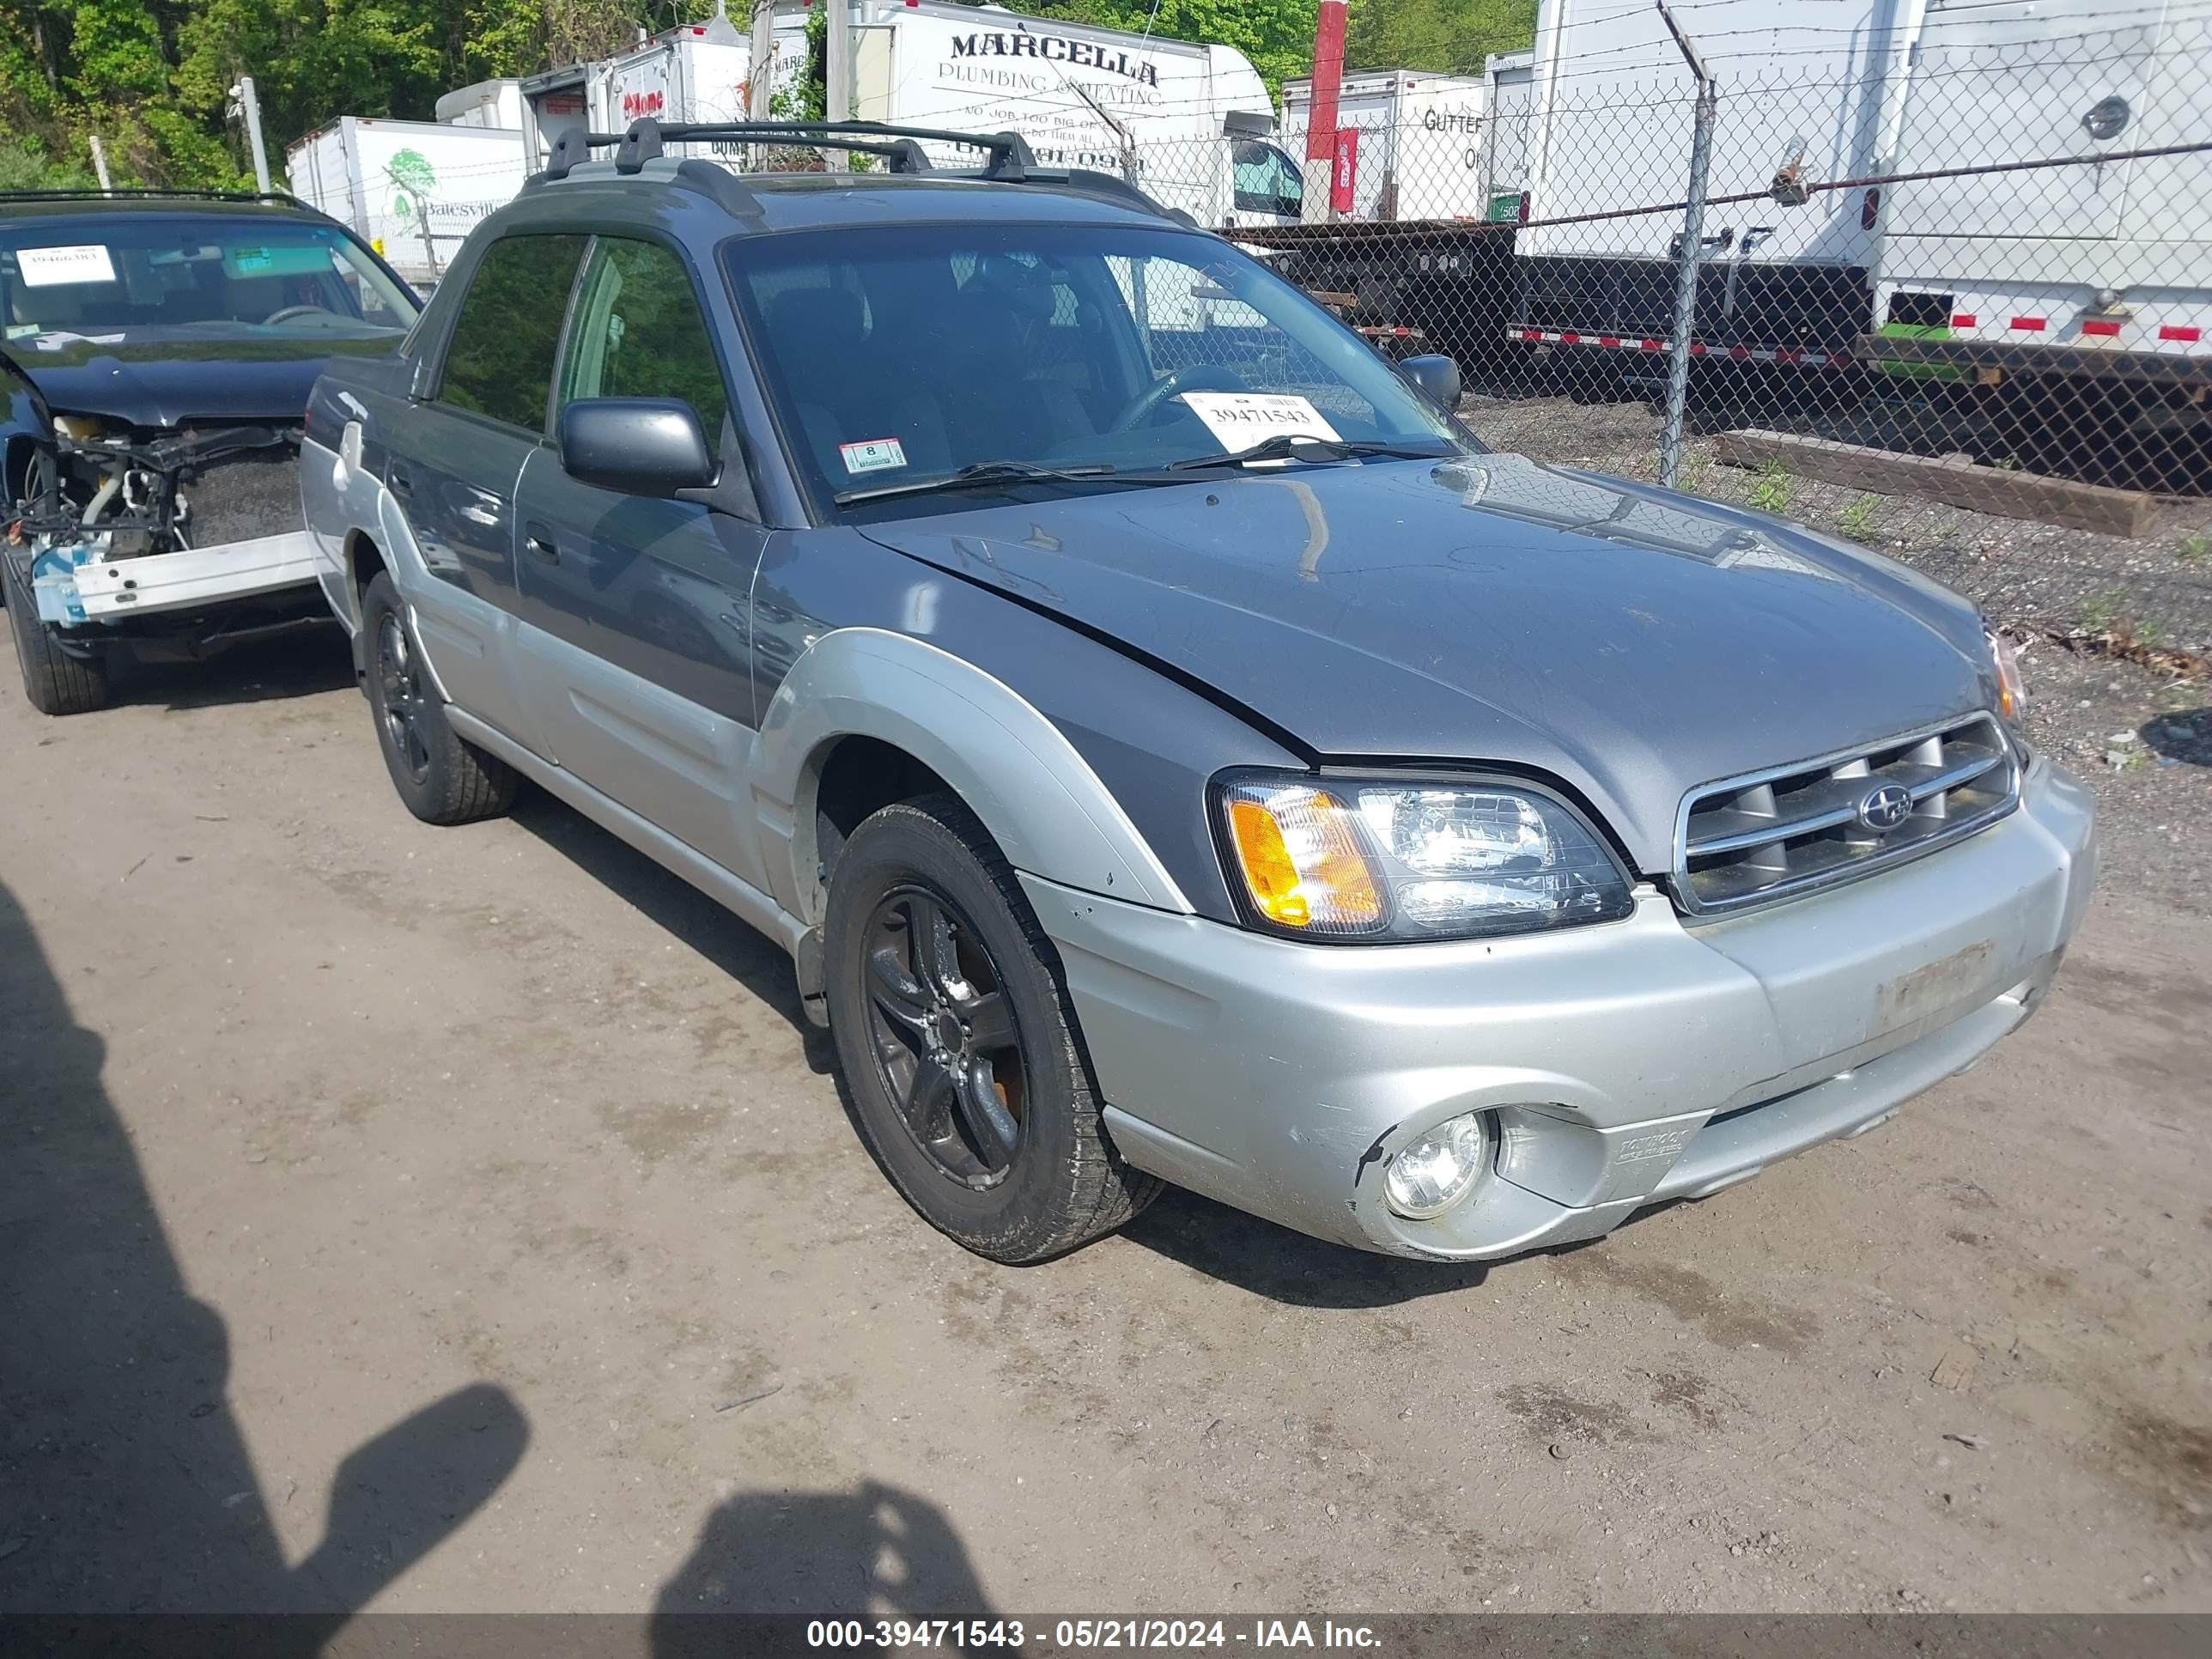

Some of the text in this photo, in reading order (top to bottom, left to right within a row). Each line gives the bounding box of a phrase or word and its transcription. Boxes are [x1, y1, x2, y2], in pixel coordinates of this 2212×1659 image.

[951, 33, 1158, 89] MARCELLA
[939, 62, 1047, 92] PLUMBING
[1082, 82, 1163, 107] EATING
[965, 106, 983, 117] NO
[989, 108, 1016, 120] JOB
[1023, 112, 1048, 124] TOO
[1054, 117, 1074, 128] BIG
[1210, 408, 1311, 424] 39471543
[866, 447, 877, 456] 8
